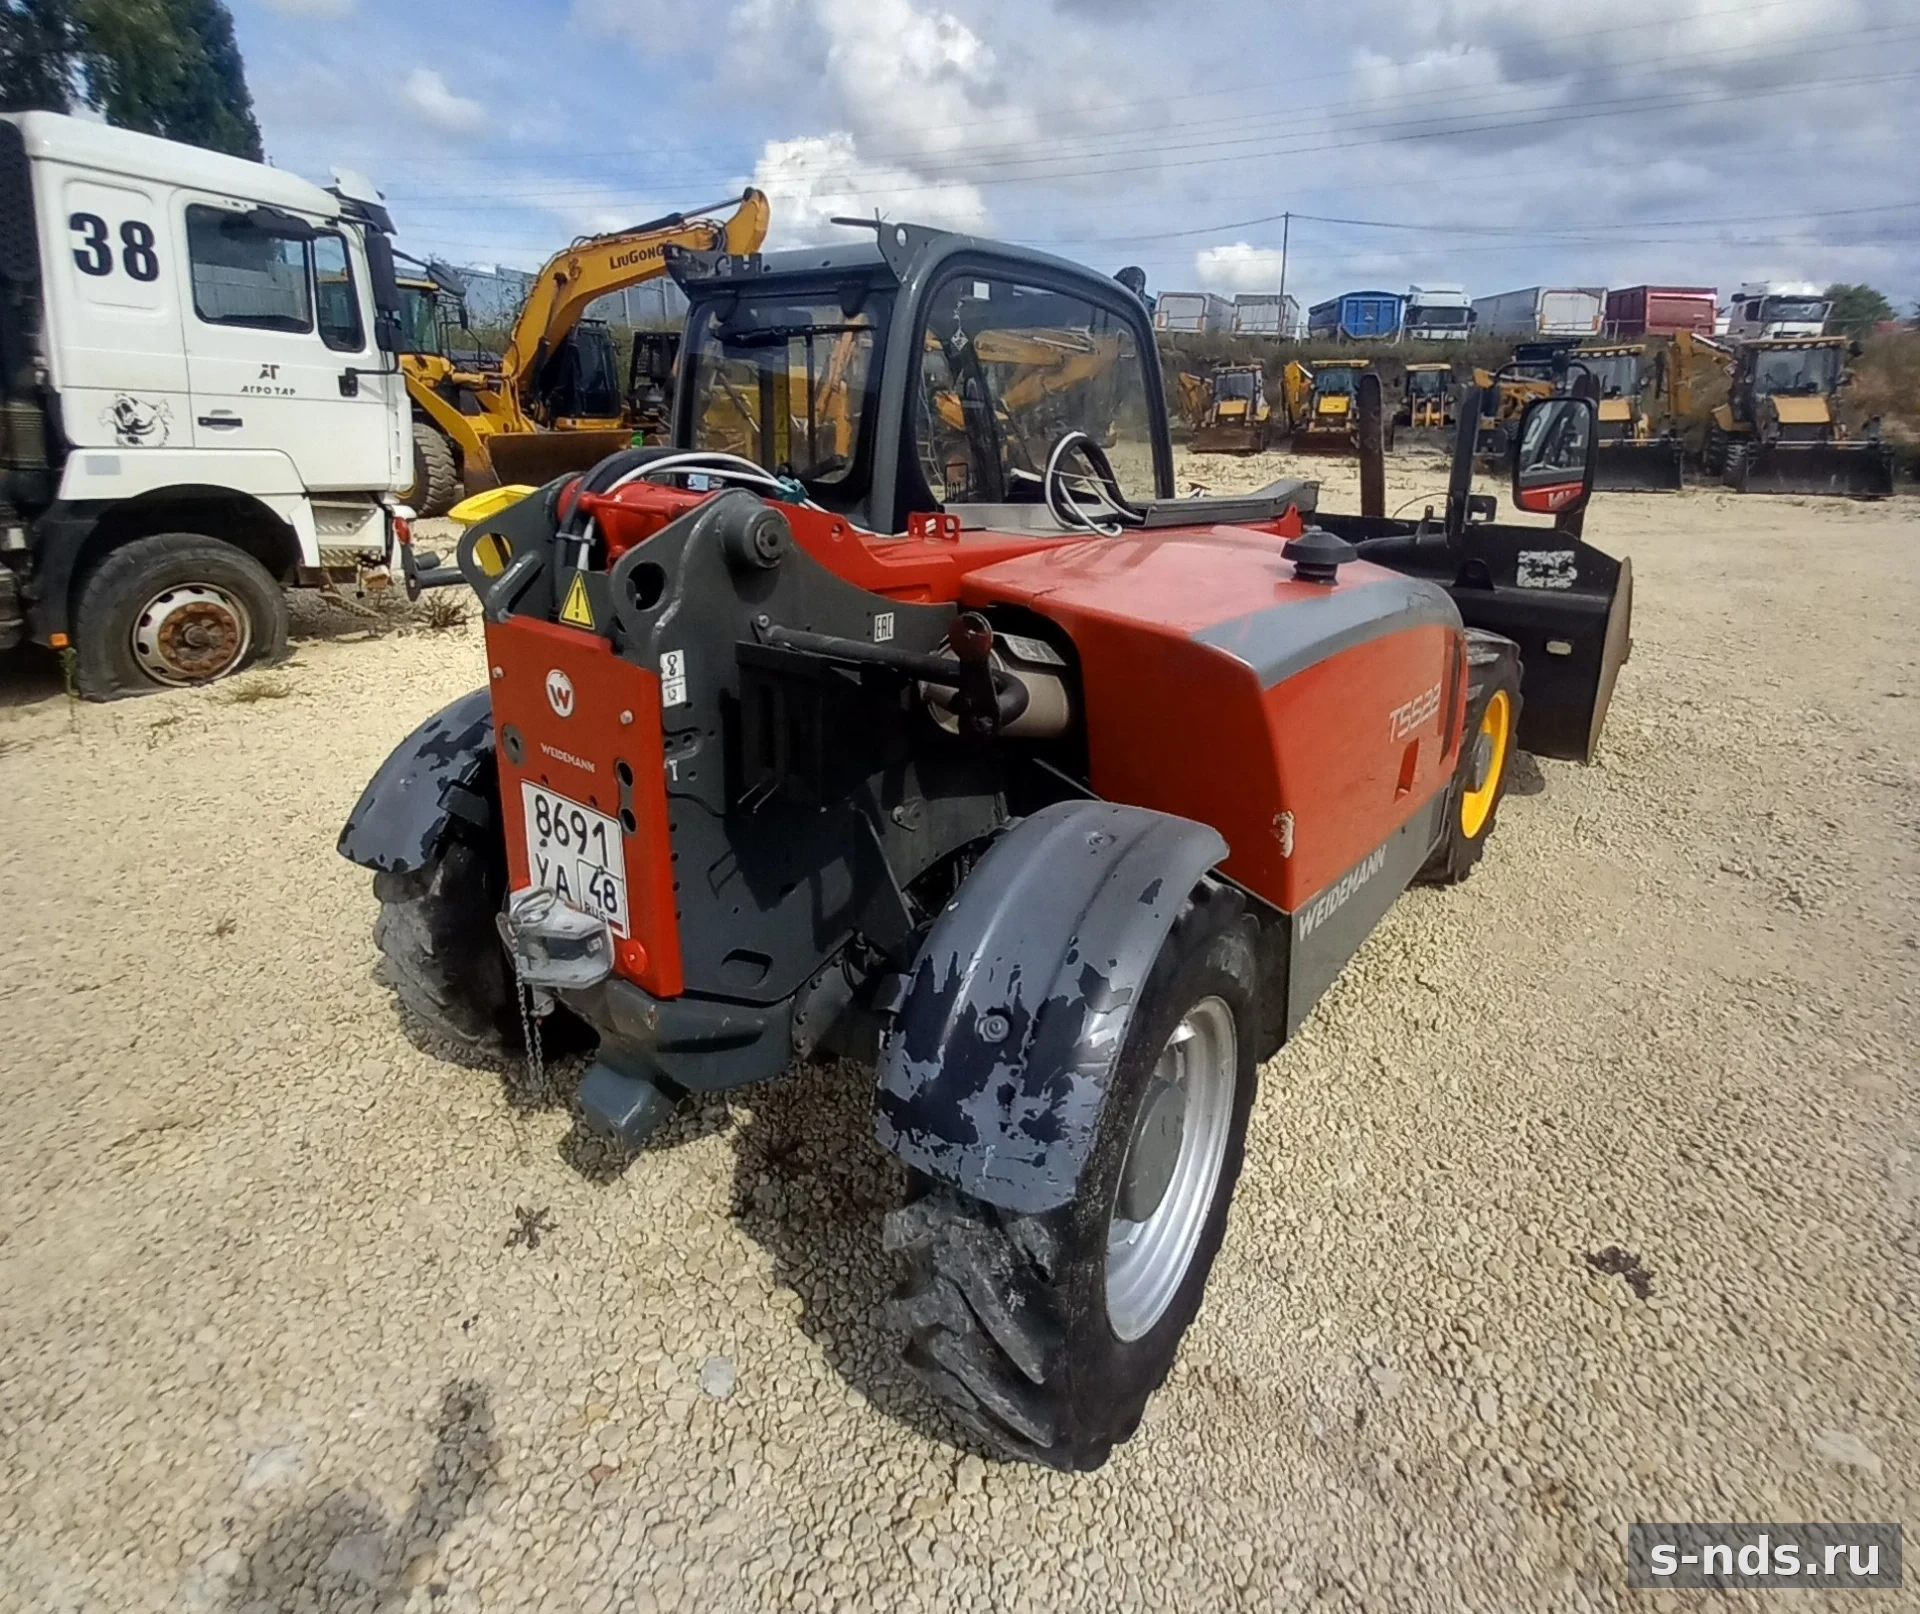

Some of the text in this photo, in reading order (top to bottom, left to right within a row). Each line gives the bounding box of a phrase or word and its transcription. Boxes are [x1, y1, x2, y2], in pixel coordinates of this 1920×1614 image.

[69, 212, 160, 282] 38
[876, 615, 892, 639] EAC
[549, 684, 571, 709] W
[540, 743, 596, 773] WEIDEMANN
[535, 794, 609, 868] 8691
[535, 852, 575, 902] УА
[589, 866, 617, 914] 48
[1299, 843, 1387, 942] WEIDEMANN
[584, 900, 607, 923] RUS
